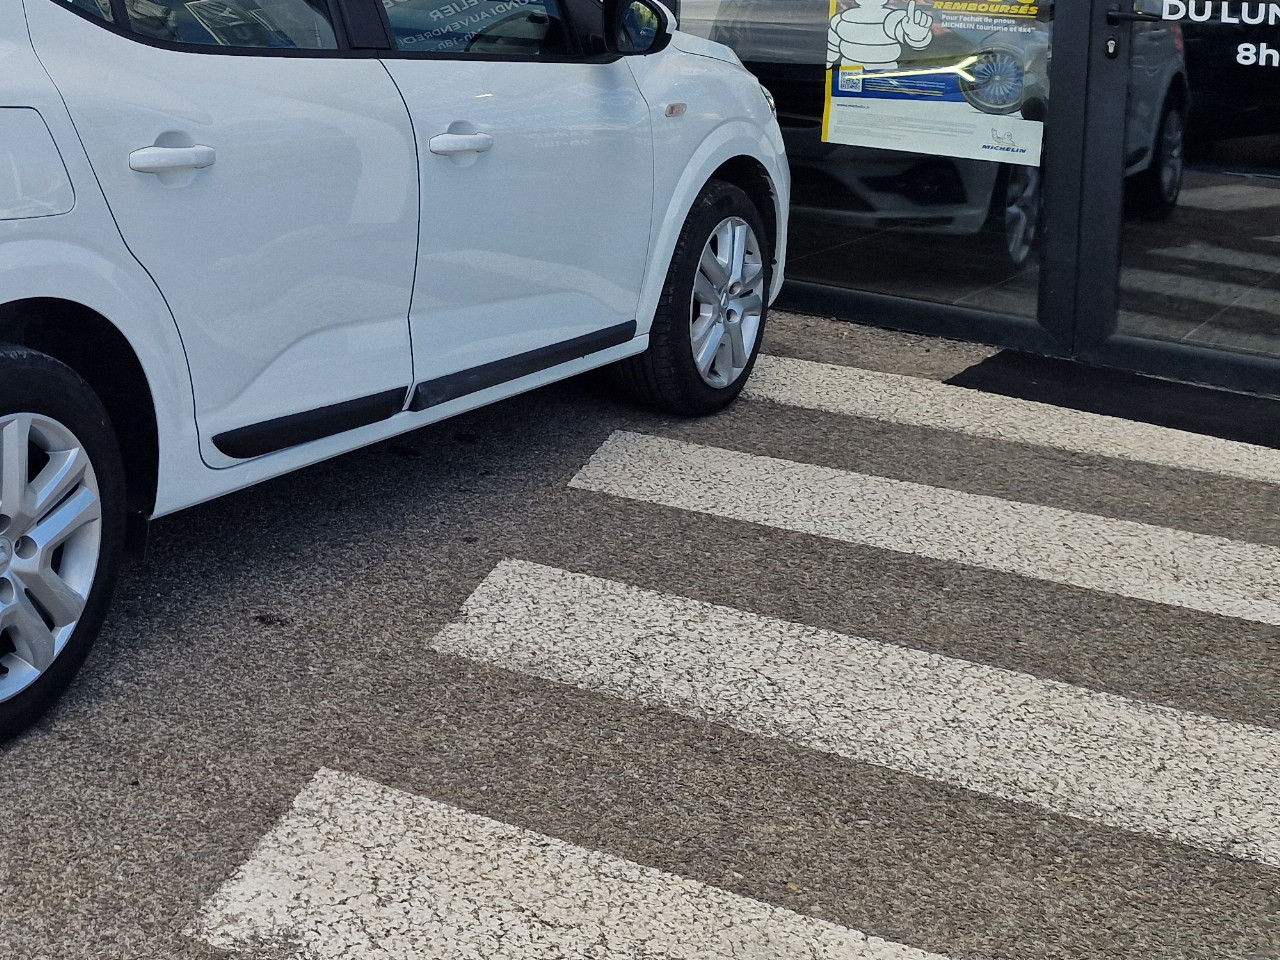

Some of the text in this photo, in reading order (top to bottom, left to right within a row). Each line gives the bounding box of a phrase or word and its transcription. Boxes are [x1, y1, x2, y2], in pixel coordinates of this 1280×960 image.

[933, 1, 1039, 15] REMBOURSÉS
[1162, 0, 1212, 22] DU
[959, 14, 982, 22] l'achat
[993, 17, 1016, 25] pneus
[941, 21, 975, 29] MICHELIN
[976, 24, 1008, 32] tourisme
[981, 144, 1026, 154] MICHELIN
